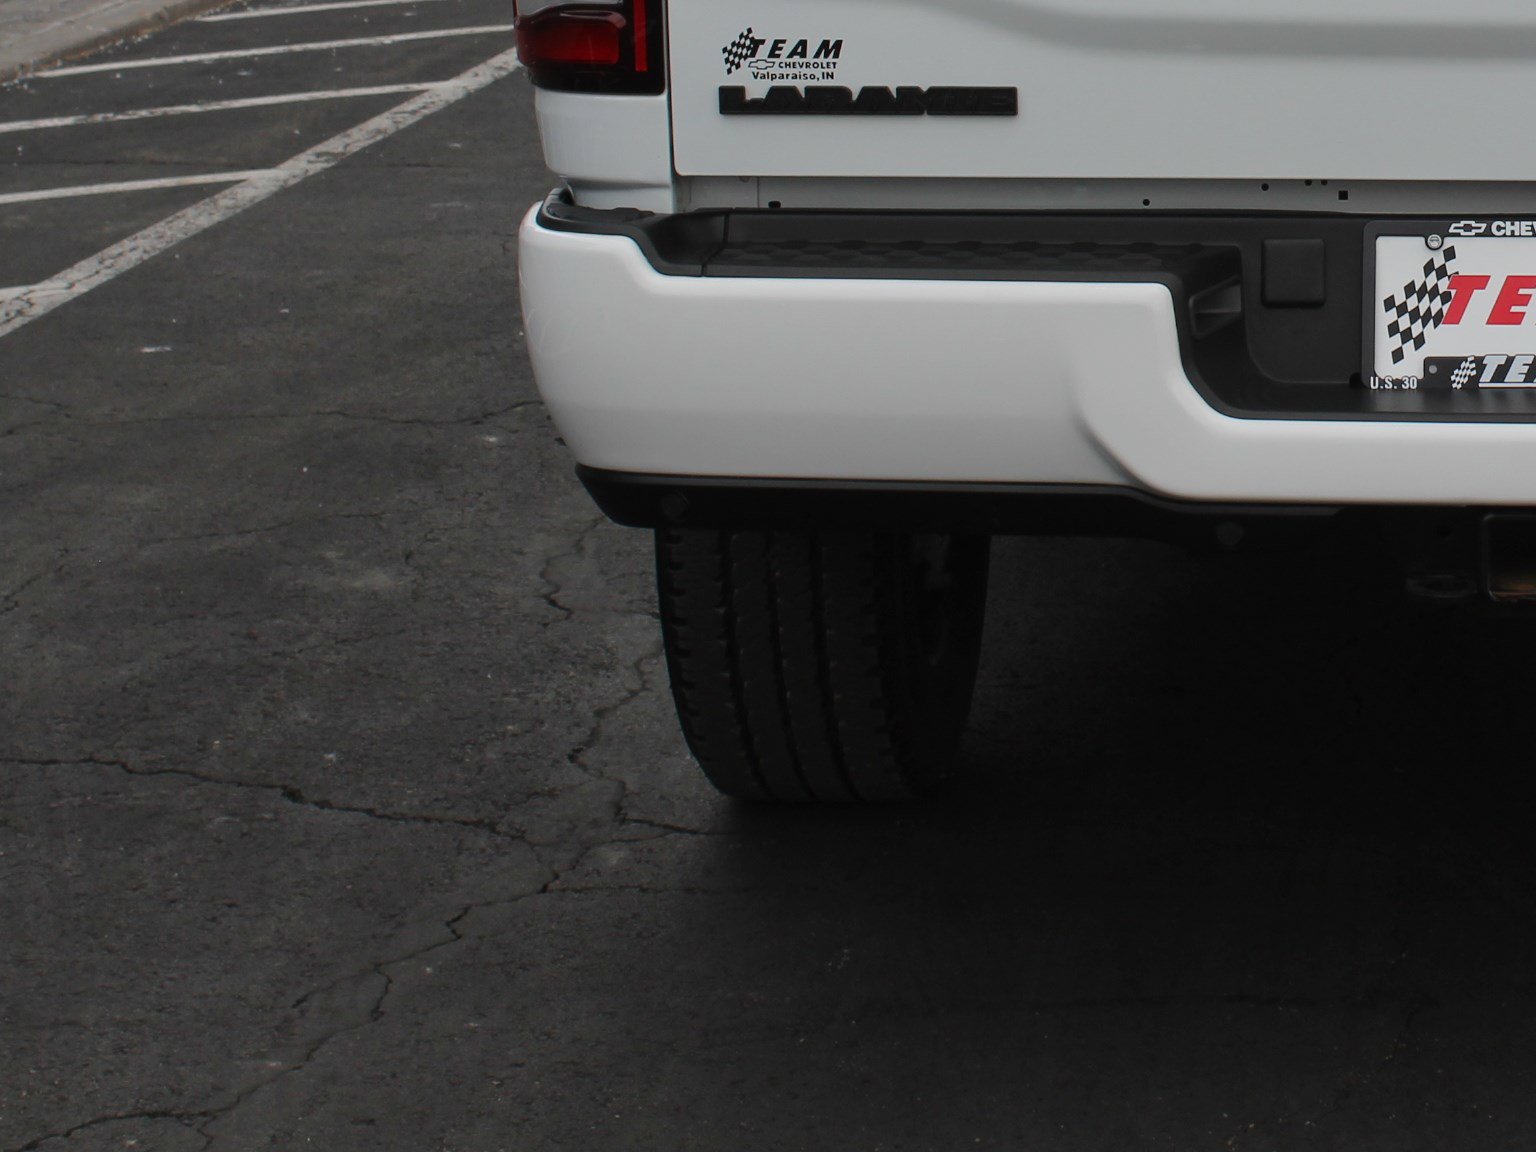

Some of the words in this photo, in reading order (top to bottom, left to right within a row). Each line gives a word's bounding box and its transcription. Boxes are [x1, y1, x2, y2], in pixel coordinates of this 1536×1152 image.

[747, 38, 843, 59] TEAM
[778, 61, 837, 69] CHEVROLET
[821, 72, 834, 80] IN
[1370, 376, 1397, 390] U.S.
[1401, 376, 1418, 390] 30
